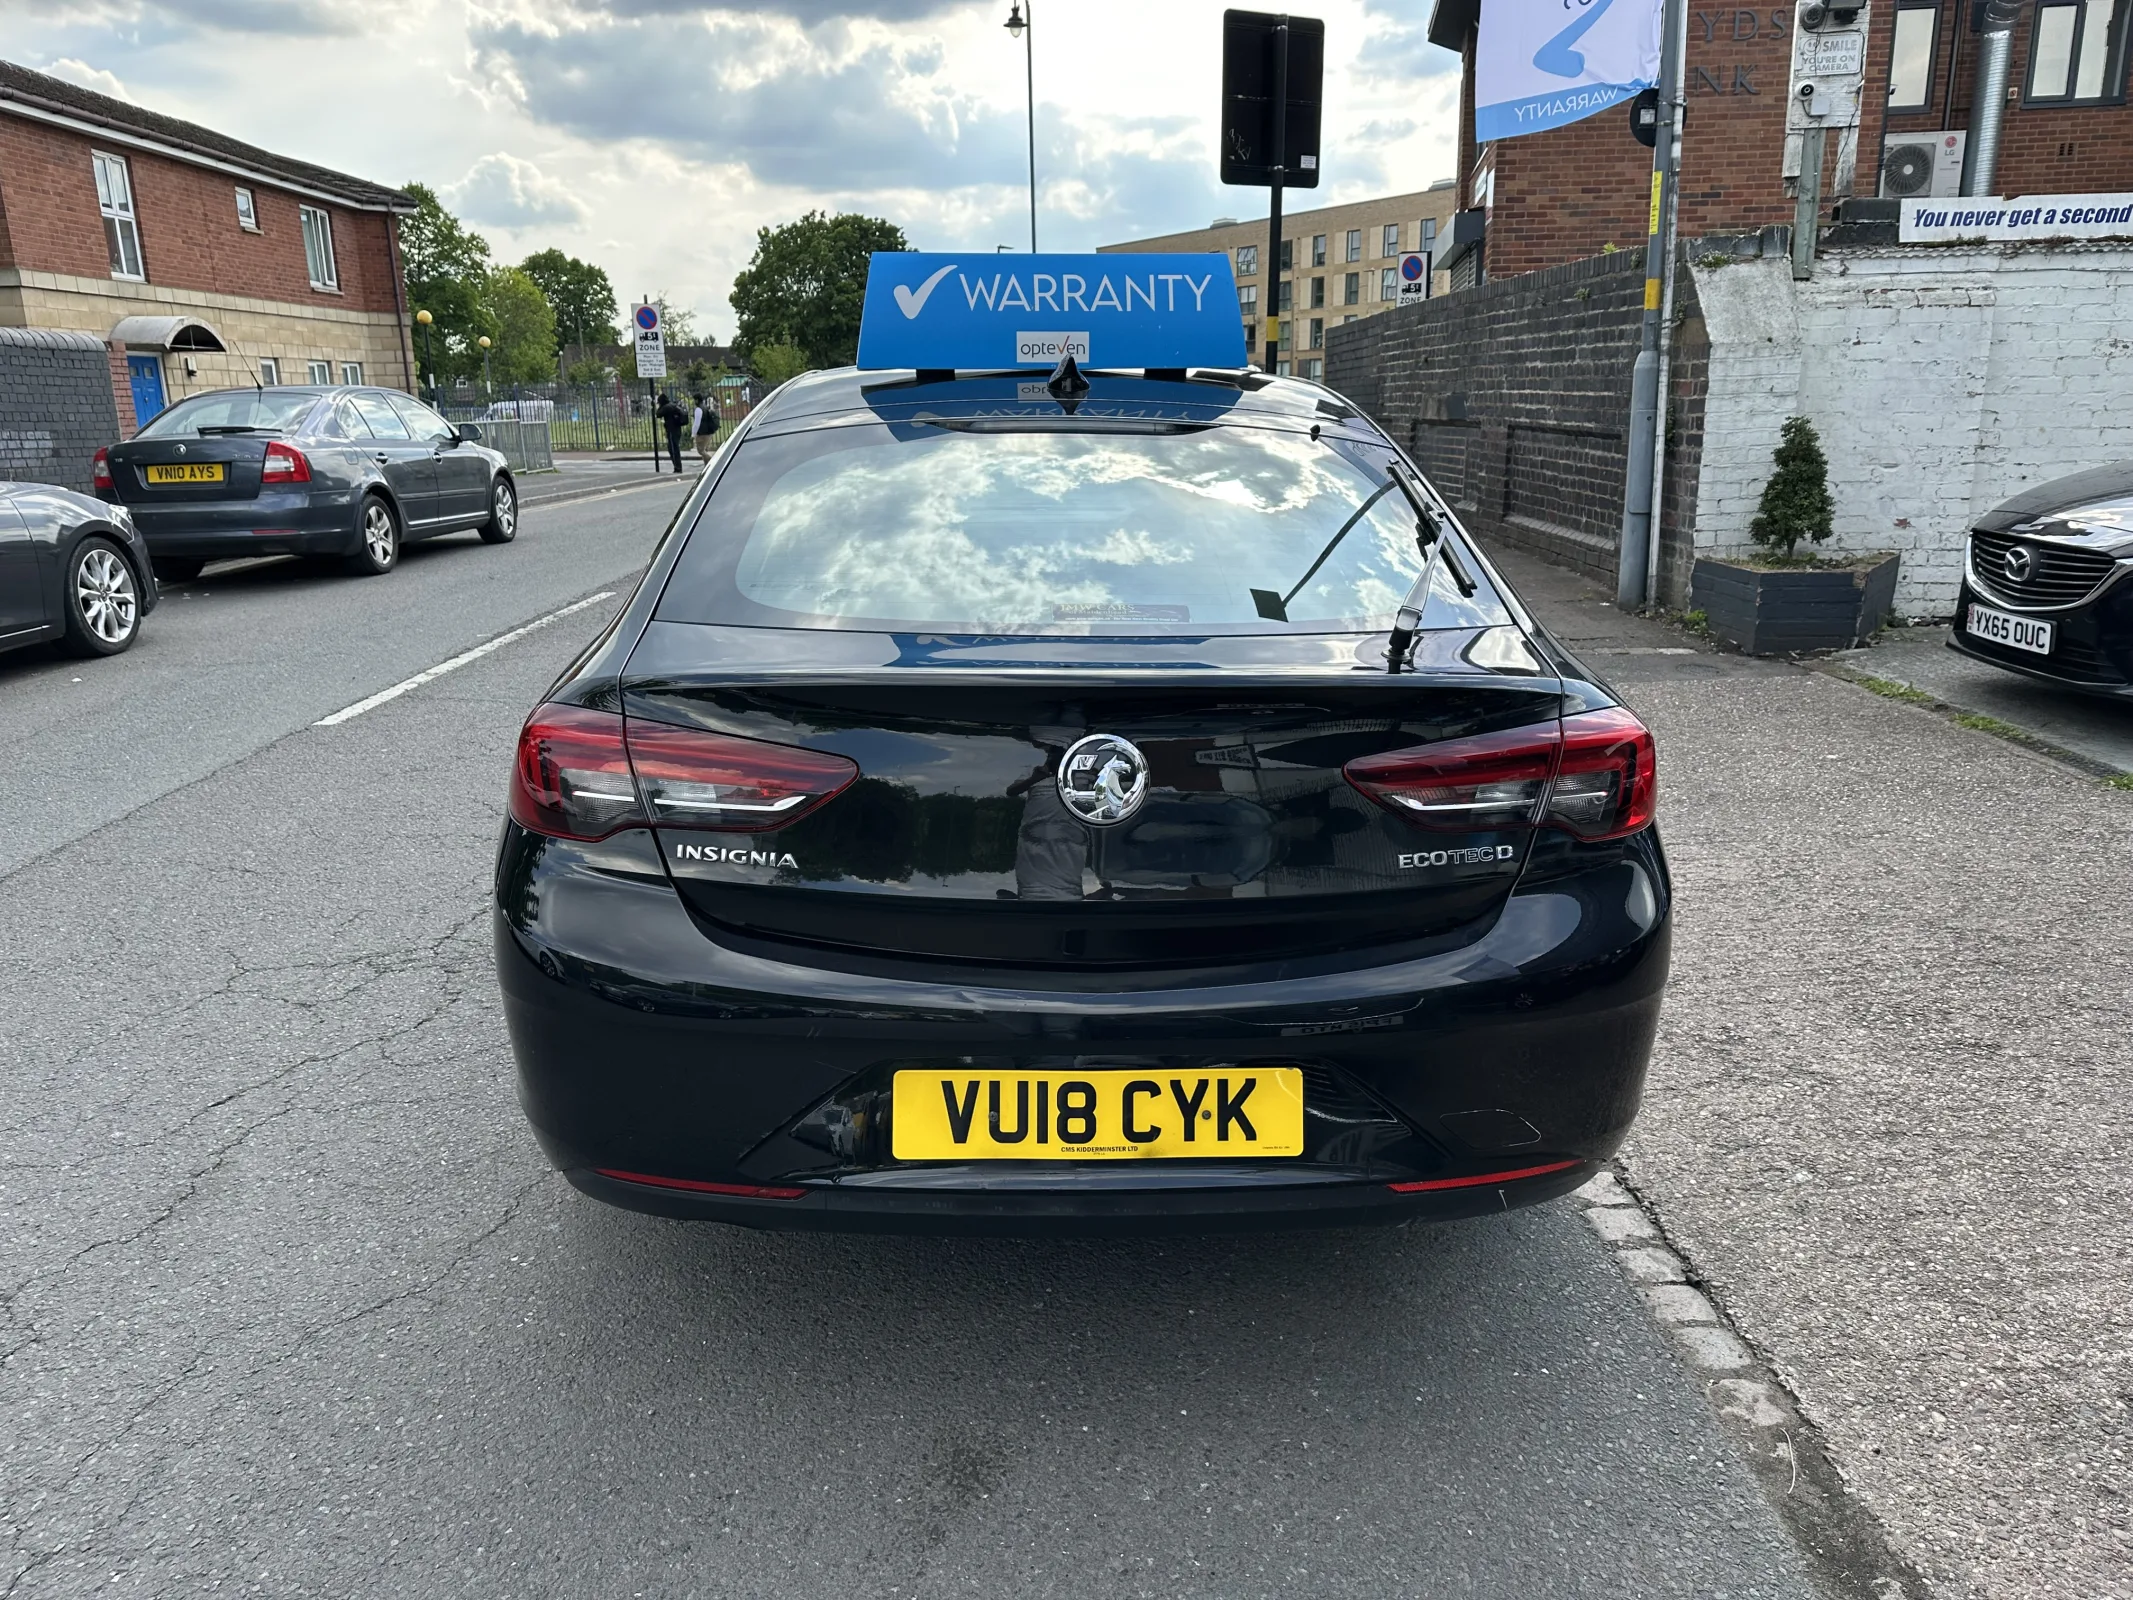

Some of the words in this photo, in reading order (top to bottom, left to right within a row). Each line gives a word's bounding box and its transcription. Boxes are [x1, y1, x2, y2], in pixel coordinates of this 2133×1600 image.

[1823, 40, 1858, 52] SMILE
[1802, 56, 1837, 64] YOU'RE
[1840, 54, 1856, 63] ON
[1809, 63, 1848, 72] CAMERA
[1915, 209, 1948, 227] You
[1950, 210, 2006, 226] never
[2007, 208, 2042, 227] get
[2044, 209, 2056, 224] a
[2060, 204, 2133, 224] second
[958, 273, 1212, 312] WARRANTY
[1020, 335, 1086, 358] opteven
[157, 467, 185, 480] VN10
[189, 466, 215, 479] AYS
[1976, 610, 2010, 640] YX65
[2014, 621, 2046, 648] OUC
[677, 844, 798, 869] INSIGNIA
[941, 1080, 1097, 1144] VU18
[1122, 1078, 1257, 1144] CYK
